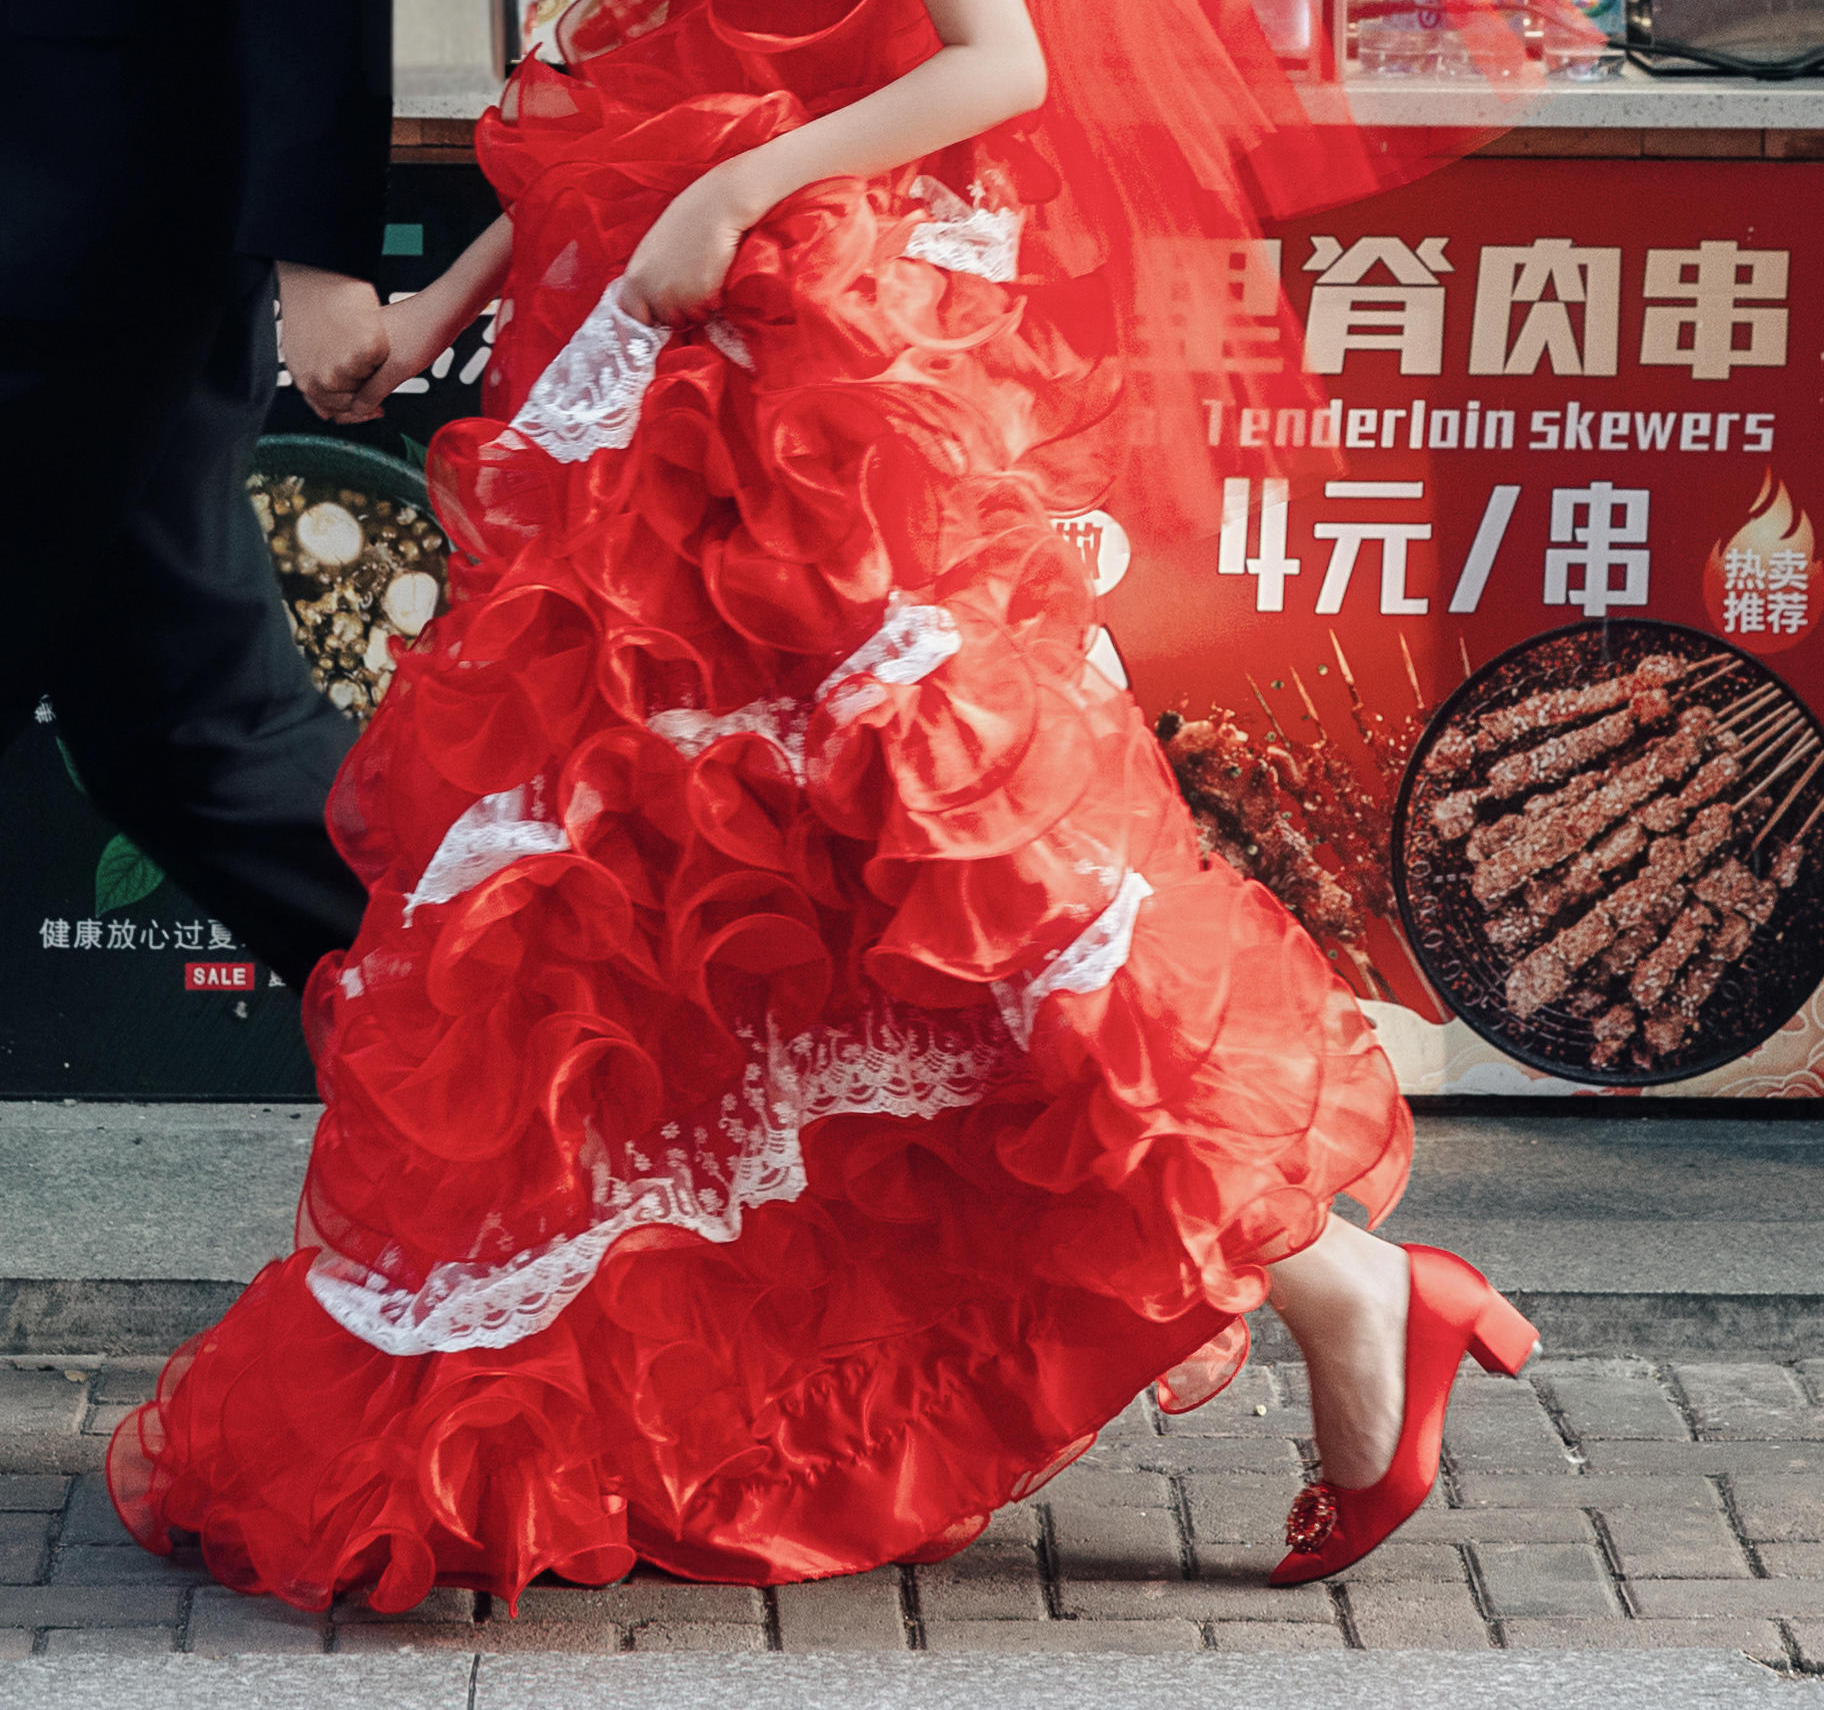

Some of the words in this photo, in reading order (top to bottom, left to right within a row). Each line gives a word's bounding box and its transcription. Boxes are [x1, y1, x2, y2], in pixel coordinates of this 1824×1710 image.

[1529, 402, 1775, 452] skewers
[1217, 477, 1651, 618] 4元/串
[1723, 546, 1809, 591] 热卖
[1723, 591, 1809, 635] 推荐
[39, 917, 247, 951] 健康放心过夏
[192, 967, 247, 986] SALE
